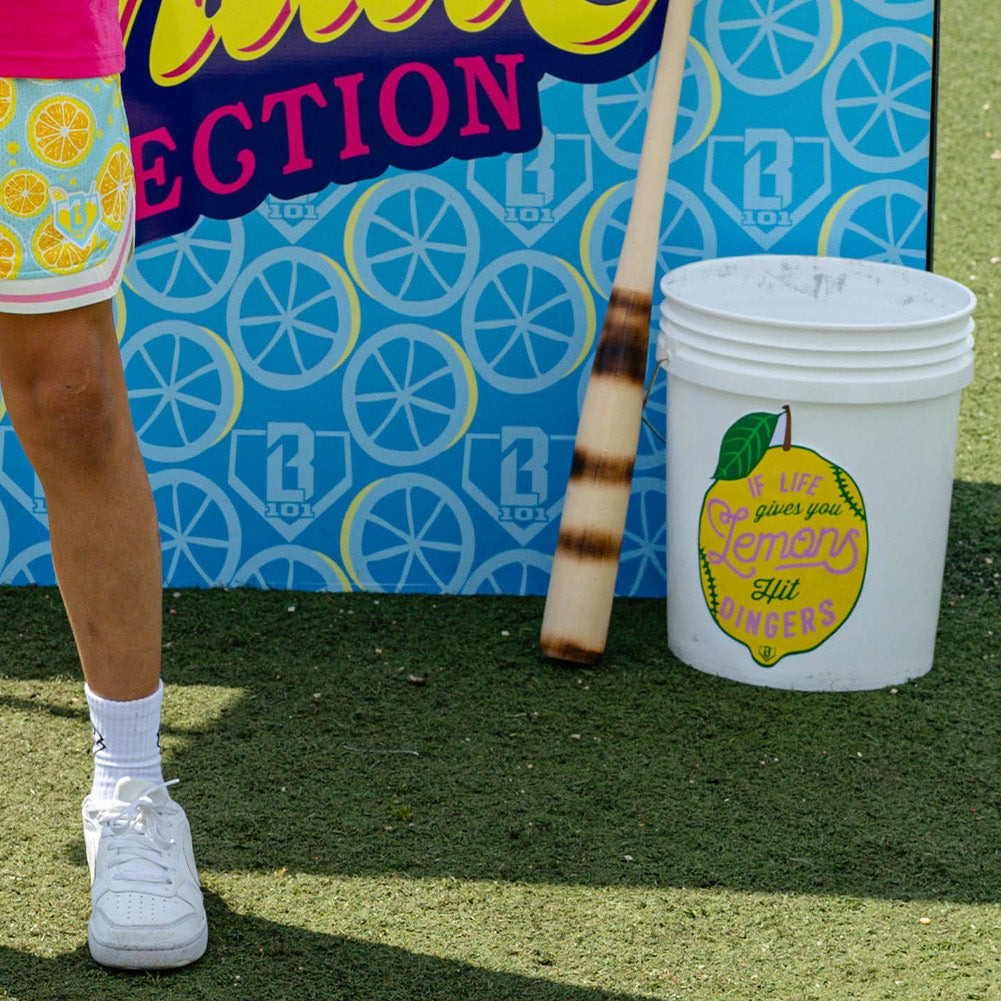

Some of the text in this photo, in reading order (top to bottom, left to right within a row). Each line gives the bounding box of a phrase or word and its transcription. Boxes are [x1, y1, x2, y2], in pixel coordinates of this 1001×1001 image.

[269, 203, 318, 219] 101
[504, 207, 553, 222] 101
[742, 210, 792, 226] 101
[748, 472, 824, 498] IF LIFE
[265, 503, 314, 518] 101
[500, 507, 549, 522] 101
[753, 501, 844, 523] gives you
[707, 498, 862, 579] Lemons
[751, 578, 802, 604] Hit
[719, 596, 836, 639] DINGERS
